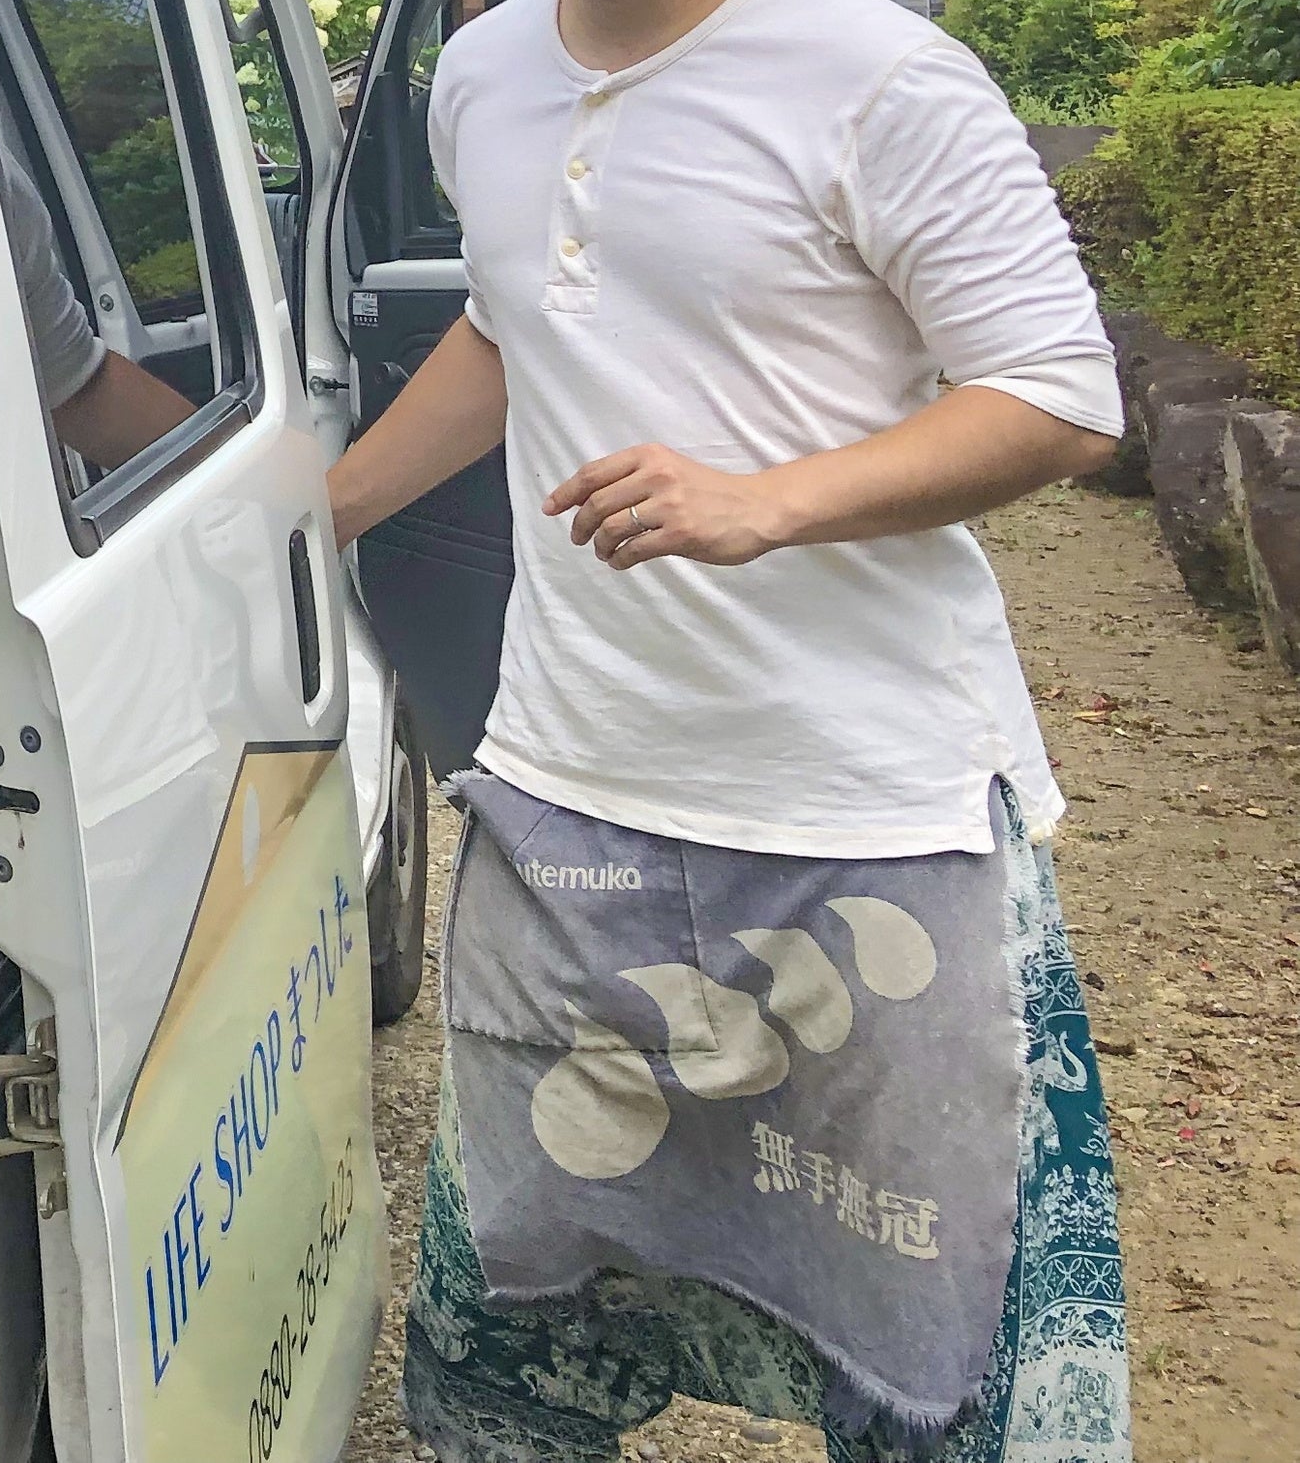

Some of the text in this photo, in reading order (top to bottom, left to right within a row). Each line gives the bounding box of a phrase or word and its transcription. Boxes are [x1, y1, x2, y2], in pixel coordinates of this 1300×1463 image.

[145, 874, 353, 1387] LIFE SHOP まつした
[750, 1120, 941, 1261] 無手無冠
[249, 1135, 353, 1463] 0880-28-5423
